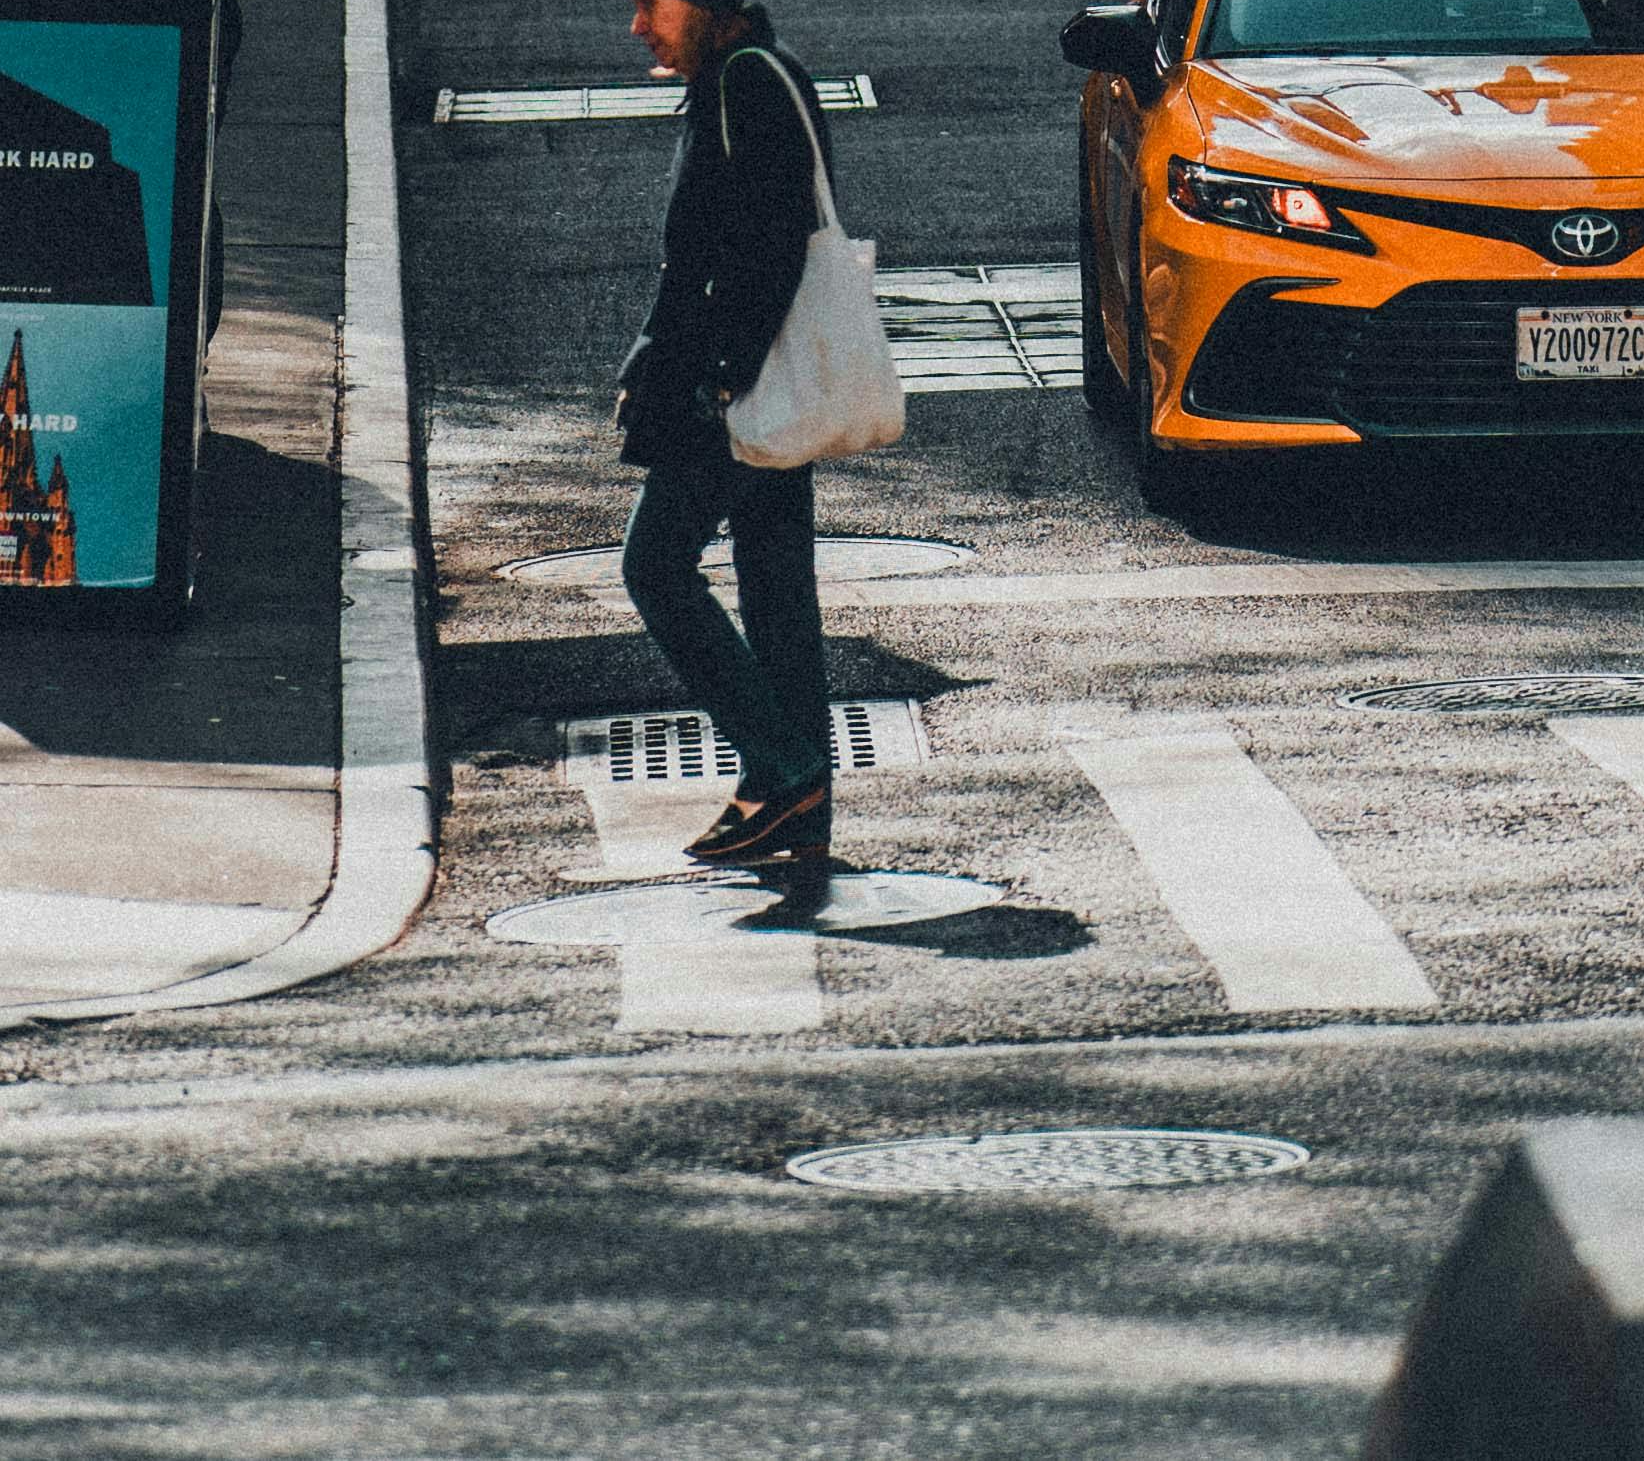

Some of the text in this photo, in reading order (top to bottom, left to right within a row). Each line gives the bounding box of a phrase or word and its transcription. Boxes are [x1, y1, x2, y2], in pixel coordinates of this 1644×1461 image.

[29, 150, 95, 169] HARD
[1551, 310, 1623, 324] NEW YORK
[1528, 326, 1644, 363] Y200972C
[1576, 365, 1600, 374] TAXI
[13, 414, 78, 432] HARD
